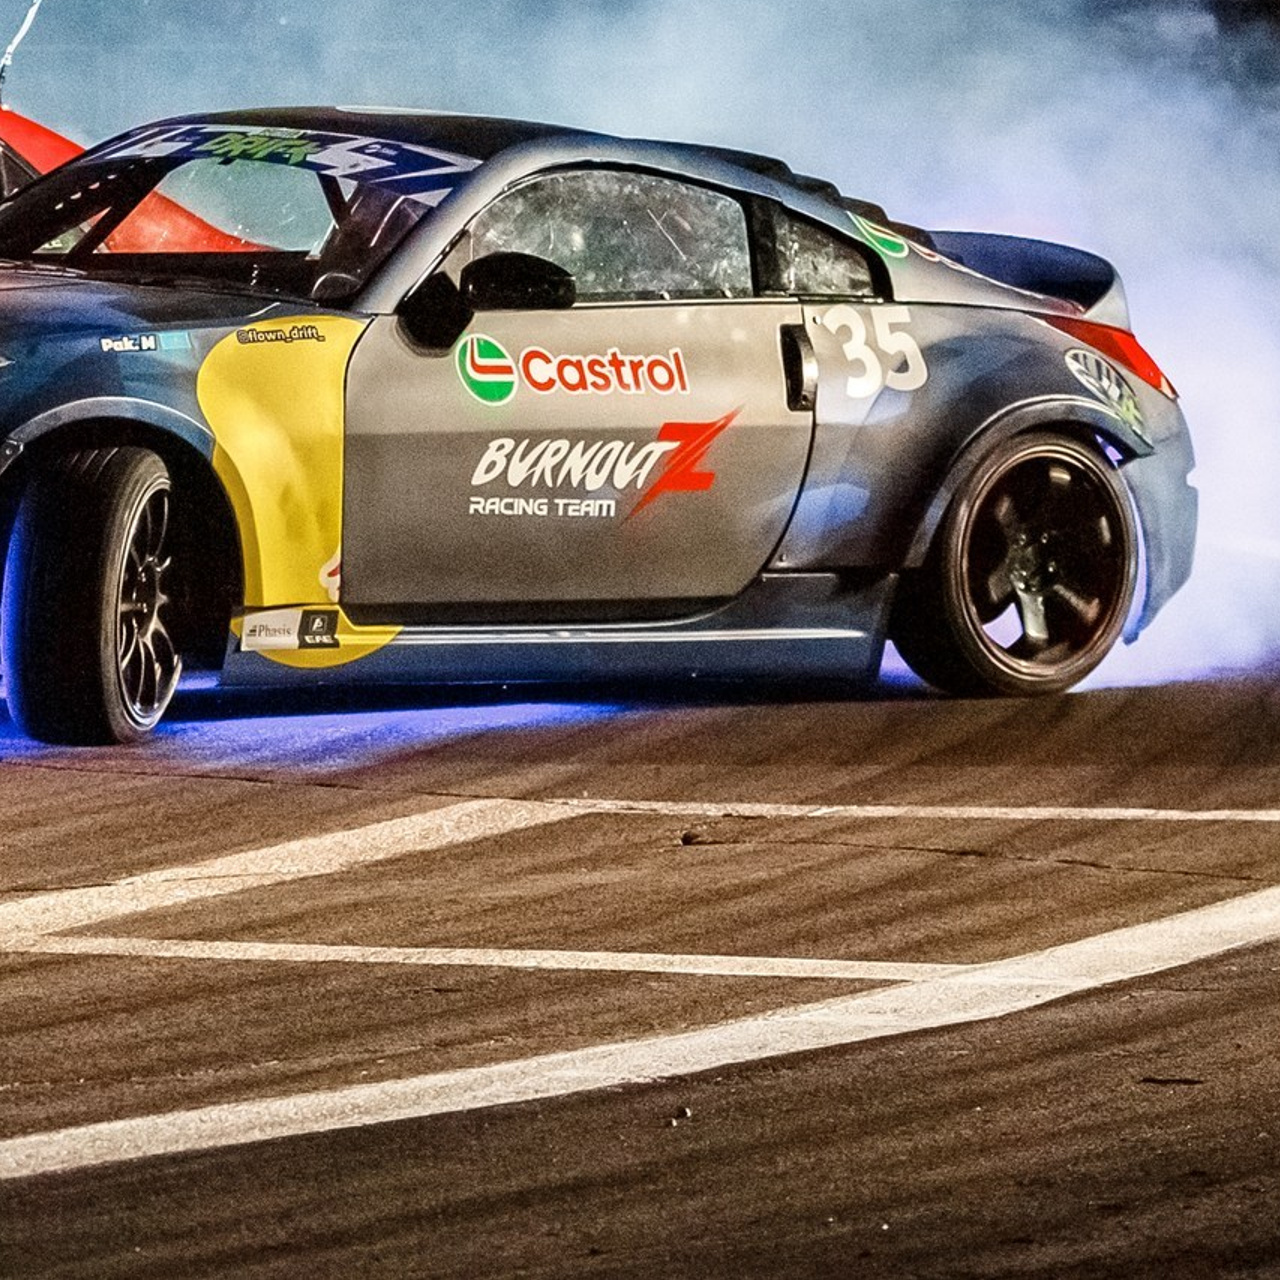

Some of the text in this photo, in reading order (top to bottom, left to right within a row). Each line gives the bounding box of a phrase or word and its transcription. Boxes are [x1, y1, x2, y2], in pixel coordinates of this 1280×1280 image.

[521, 346, 689, 394] Castrol
[821, 304, 929, 399] 35
[470, 437, 682, 491] BURNOUT
[469, 496, 616, 517] RACING TEAM
